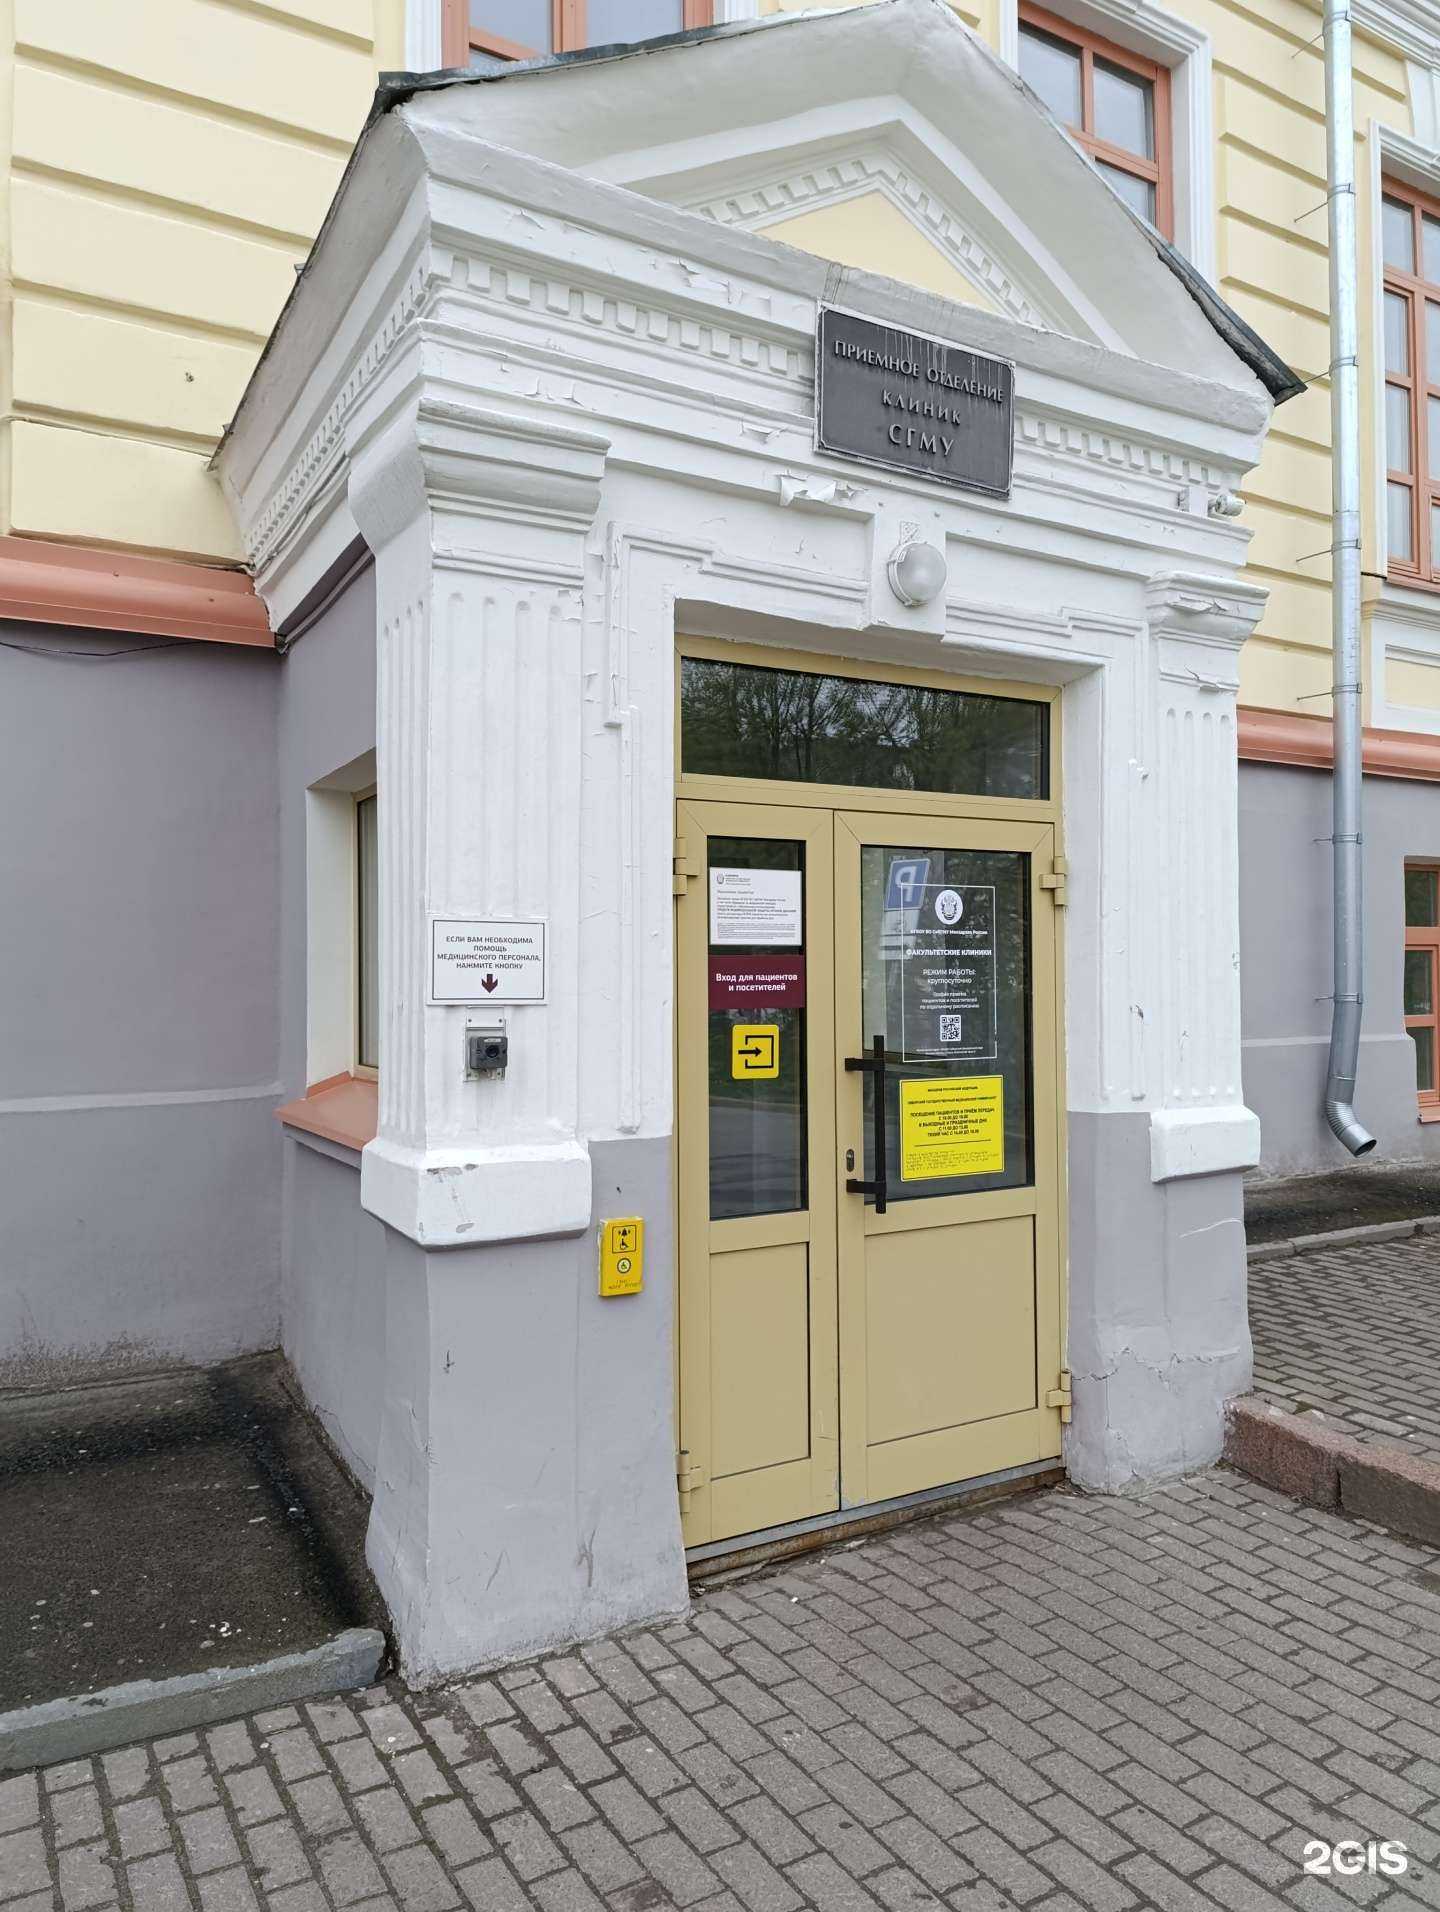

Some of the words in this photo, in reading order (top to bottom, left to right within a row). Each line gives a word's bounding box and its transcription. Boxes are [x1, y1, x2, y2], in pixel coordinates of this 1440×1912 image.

[834, 340, 919, 377] ПРИЕМНОЕ
[927, 367, 1005, 403] ОТДЕЛЕНИЕ
[882, 389, 961, 425] КЛИНИК
[889, 424, 954, 456] СГМУ
[473, 945, 507, 953] ПОМОЩЬ
[906, 948, 961, 956] ФАКУЛЬТЕТСКИЕ
[437, 953, 496, 961] МЕДИЦИНСКОГО
[715, 973, 737, 983] Вход
[738, 974, 754, 982] для
[755, 974, 798, 982] пациентов
[736, 983, 786, 991] посетителей
